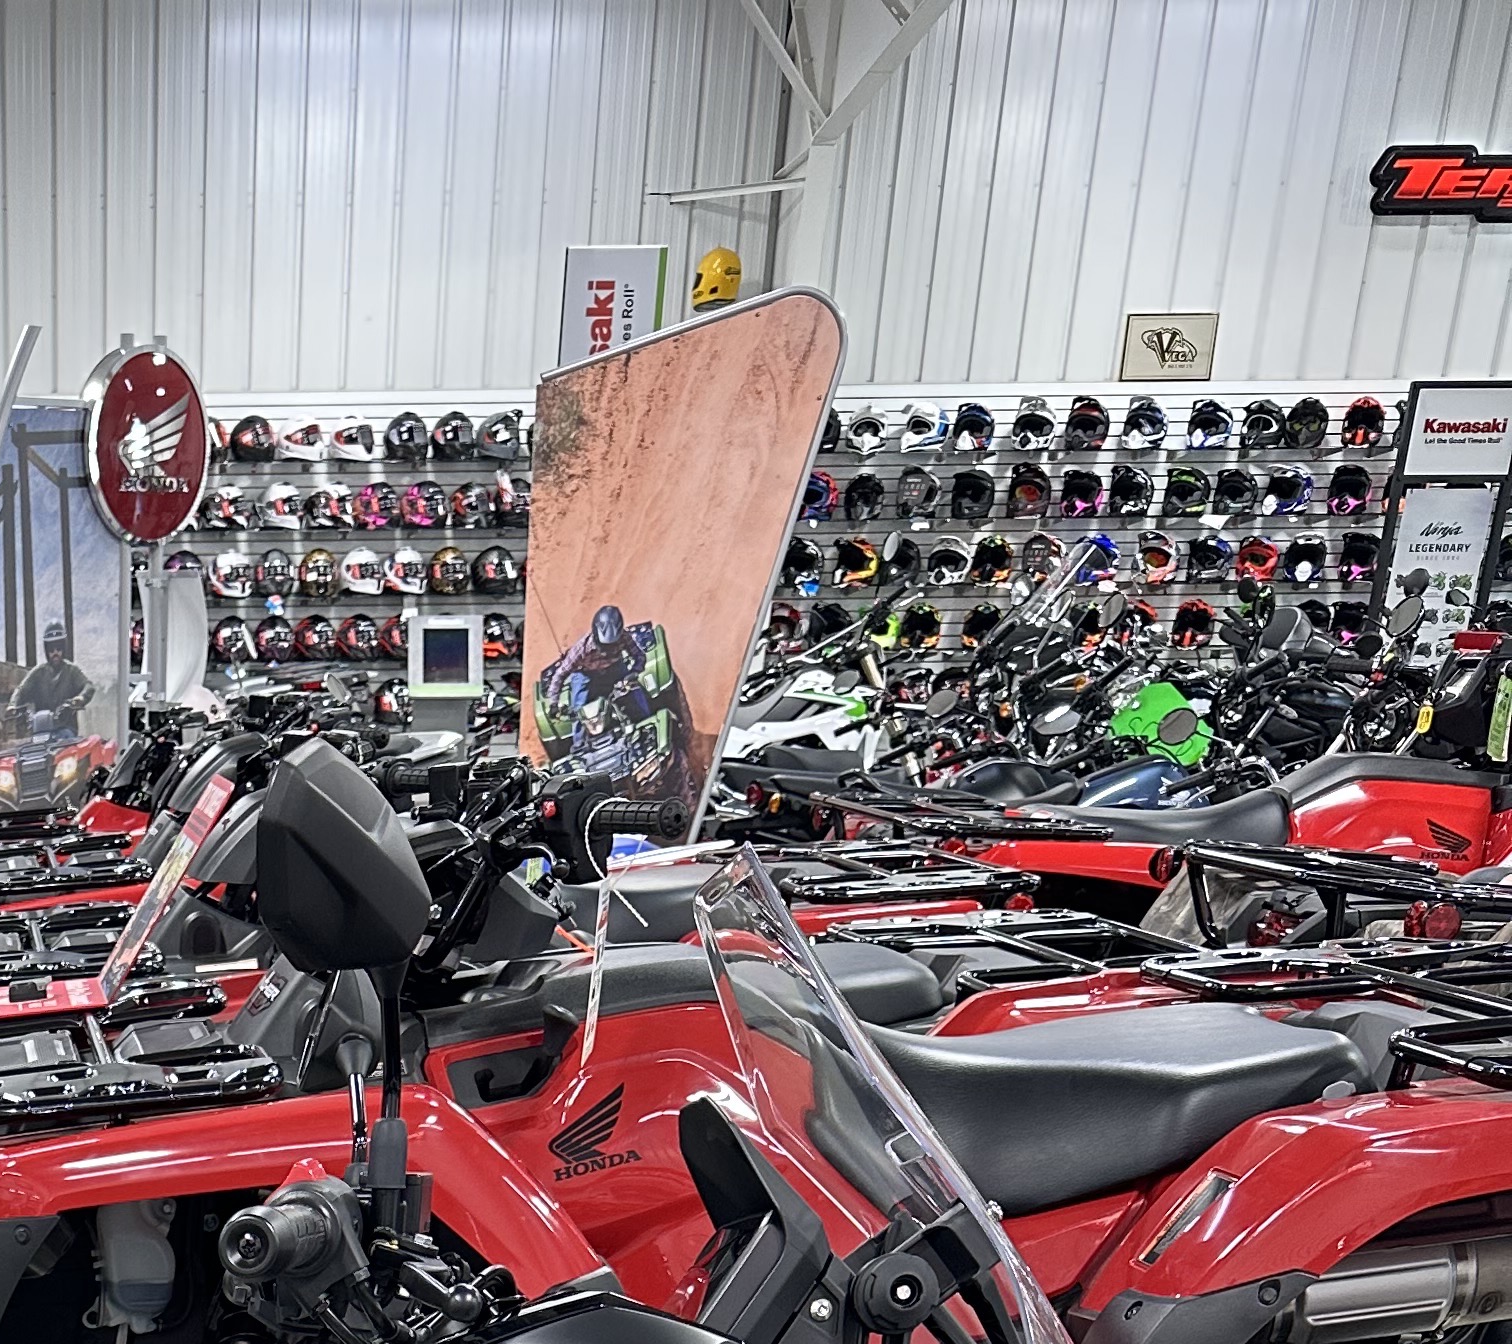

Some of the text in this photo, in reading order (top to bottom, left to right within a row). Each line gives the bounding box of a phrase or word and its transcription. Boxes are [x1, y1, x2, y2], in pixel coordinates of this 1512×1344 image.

[1423, 417, 1509, 434] Kawasaki
[1419, 521, 1464, 541] Ninja
[1408, 543, 1472, 553] LEGENDARY
[1419, 851, 1470, 862] HONDA
[553, 1149, 642, 1182] HONDA
